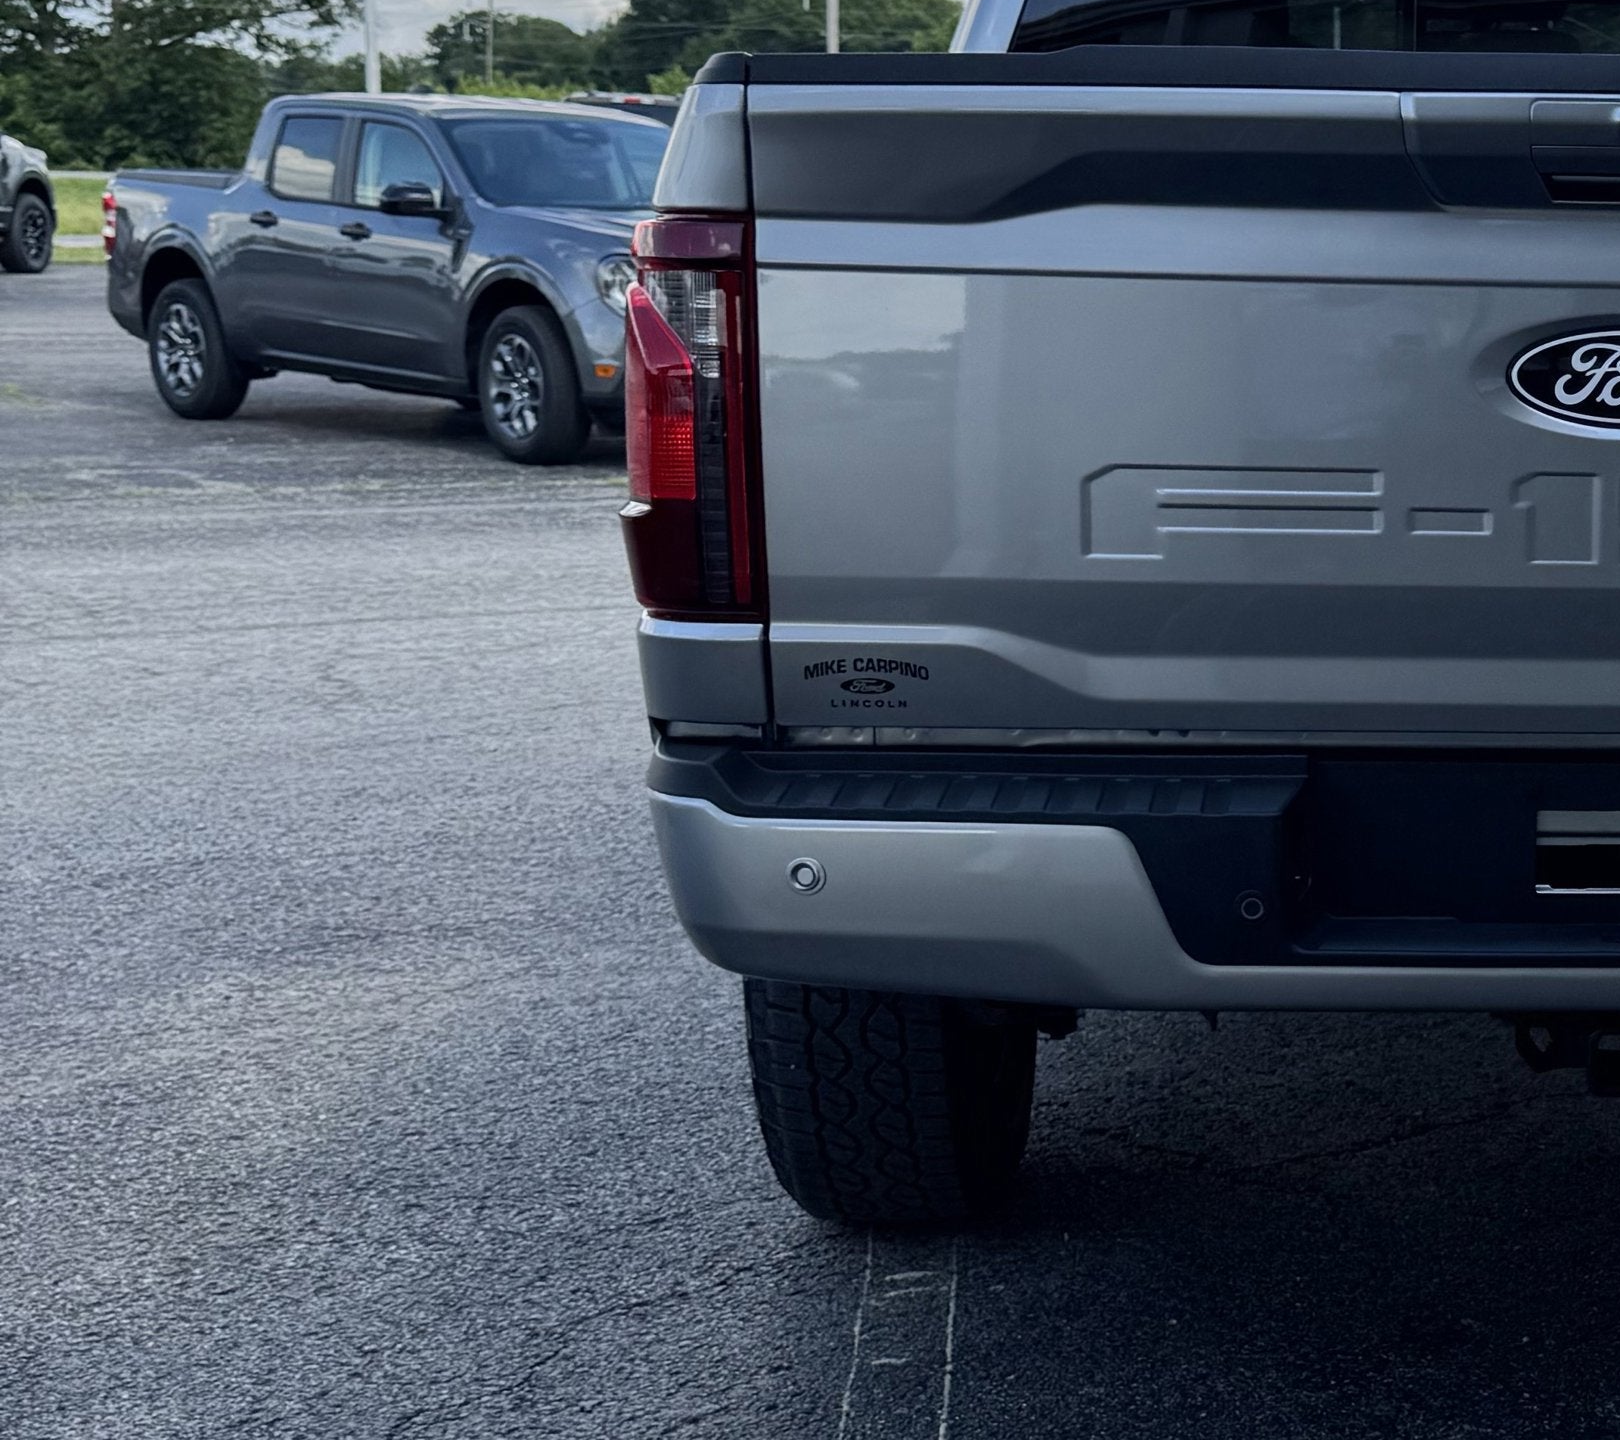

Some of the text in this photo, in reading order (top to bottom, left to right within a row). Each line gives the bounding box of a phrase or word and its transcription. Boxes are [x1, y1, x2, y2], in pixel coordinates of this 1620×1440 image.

[804, 657, 930, 681] MIKE CARPINO
[830, 698, 908, 709] LINCOLN
